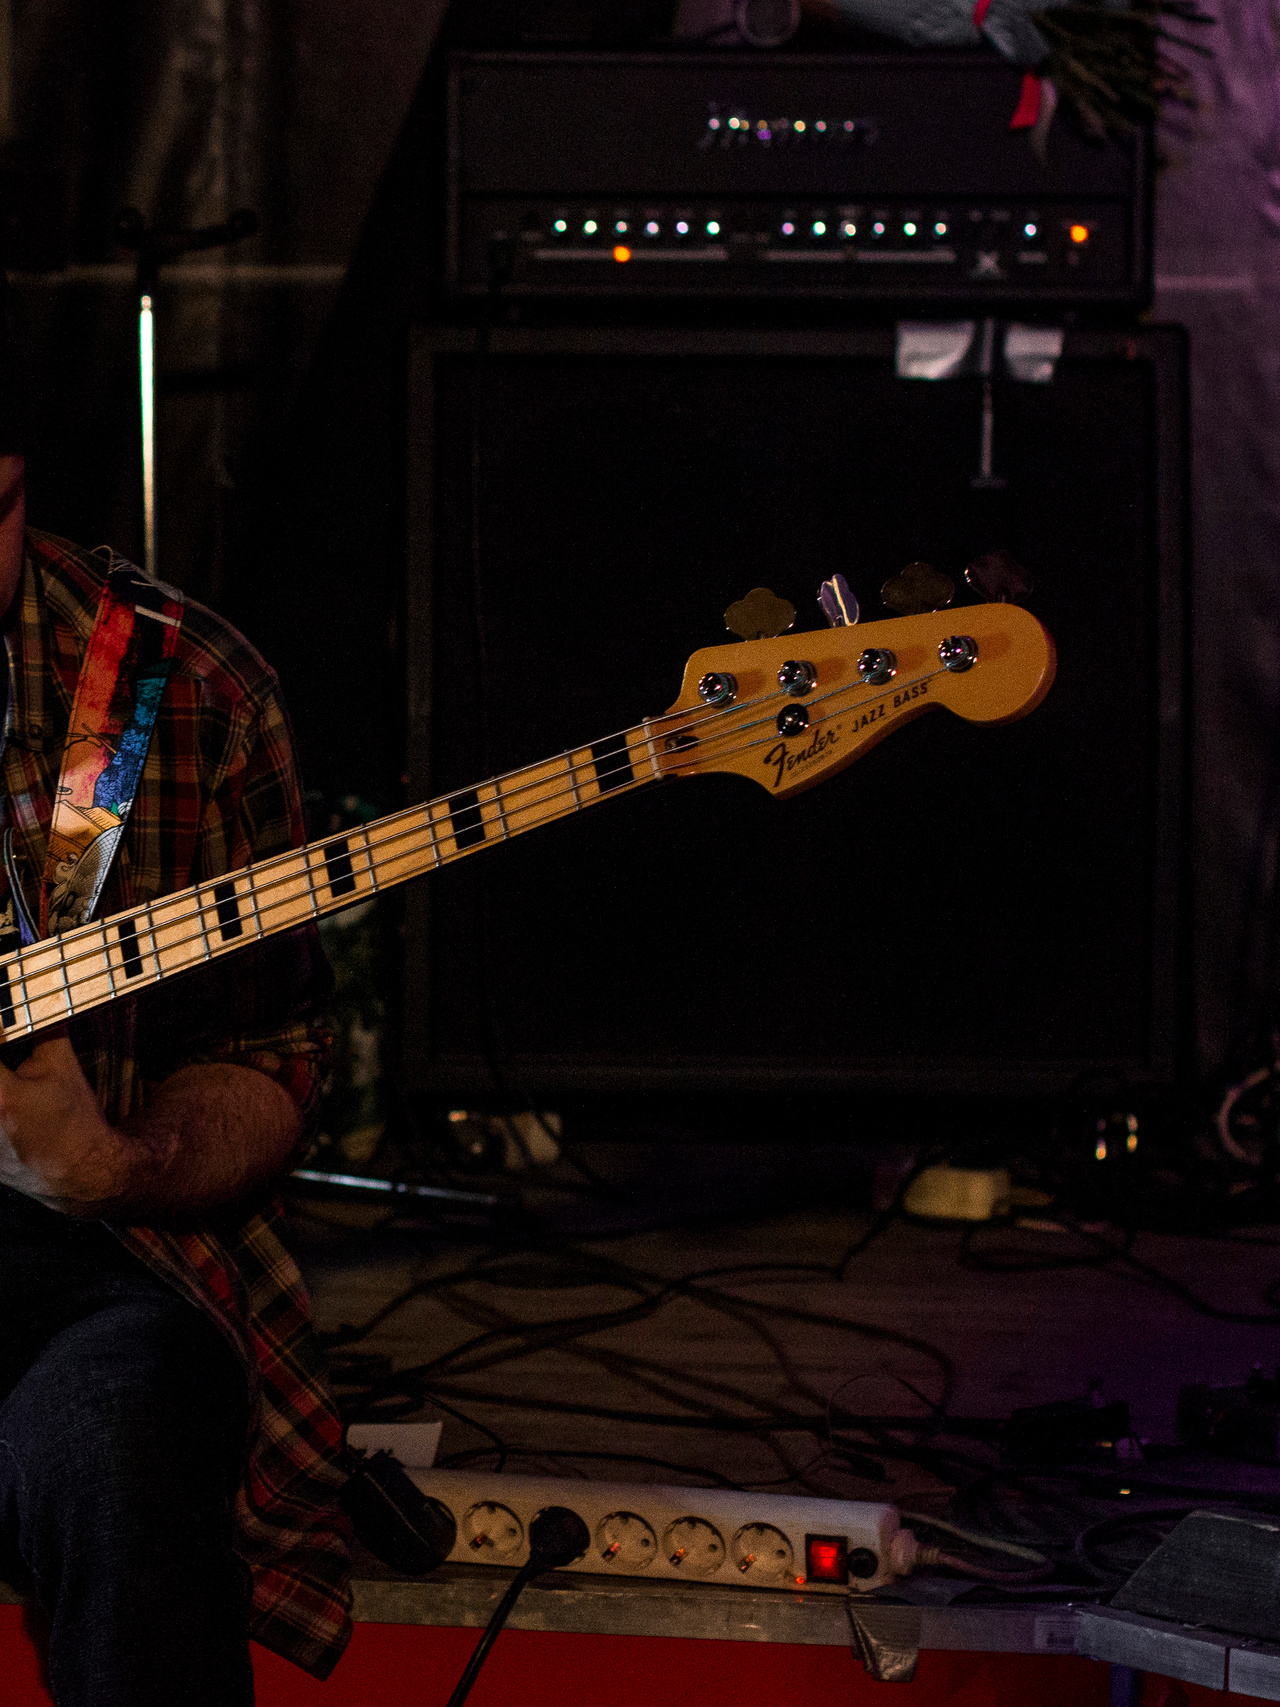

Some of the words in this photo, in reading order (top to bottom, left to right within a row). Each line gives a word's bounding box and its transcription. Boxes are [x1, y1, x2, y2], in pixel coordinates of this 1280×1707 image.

[851, 704, 886, 733] JAZZ
[893, 681, 929, 708] BASS
[764, 728, 840, 788] Fender
